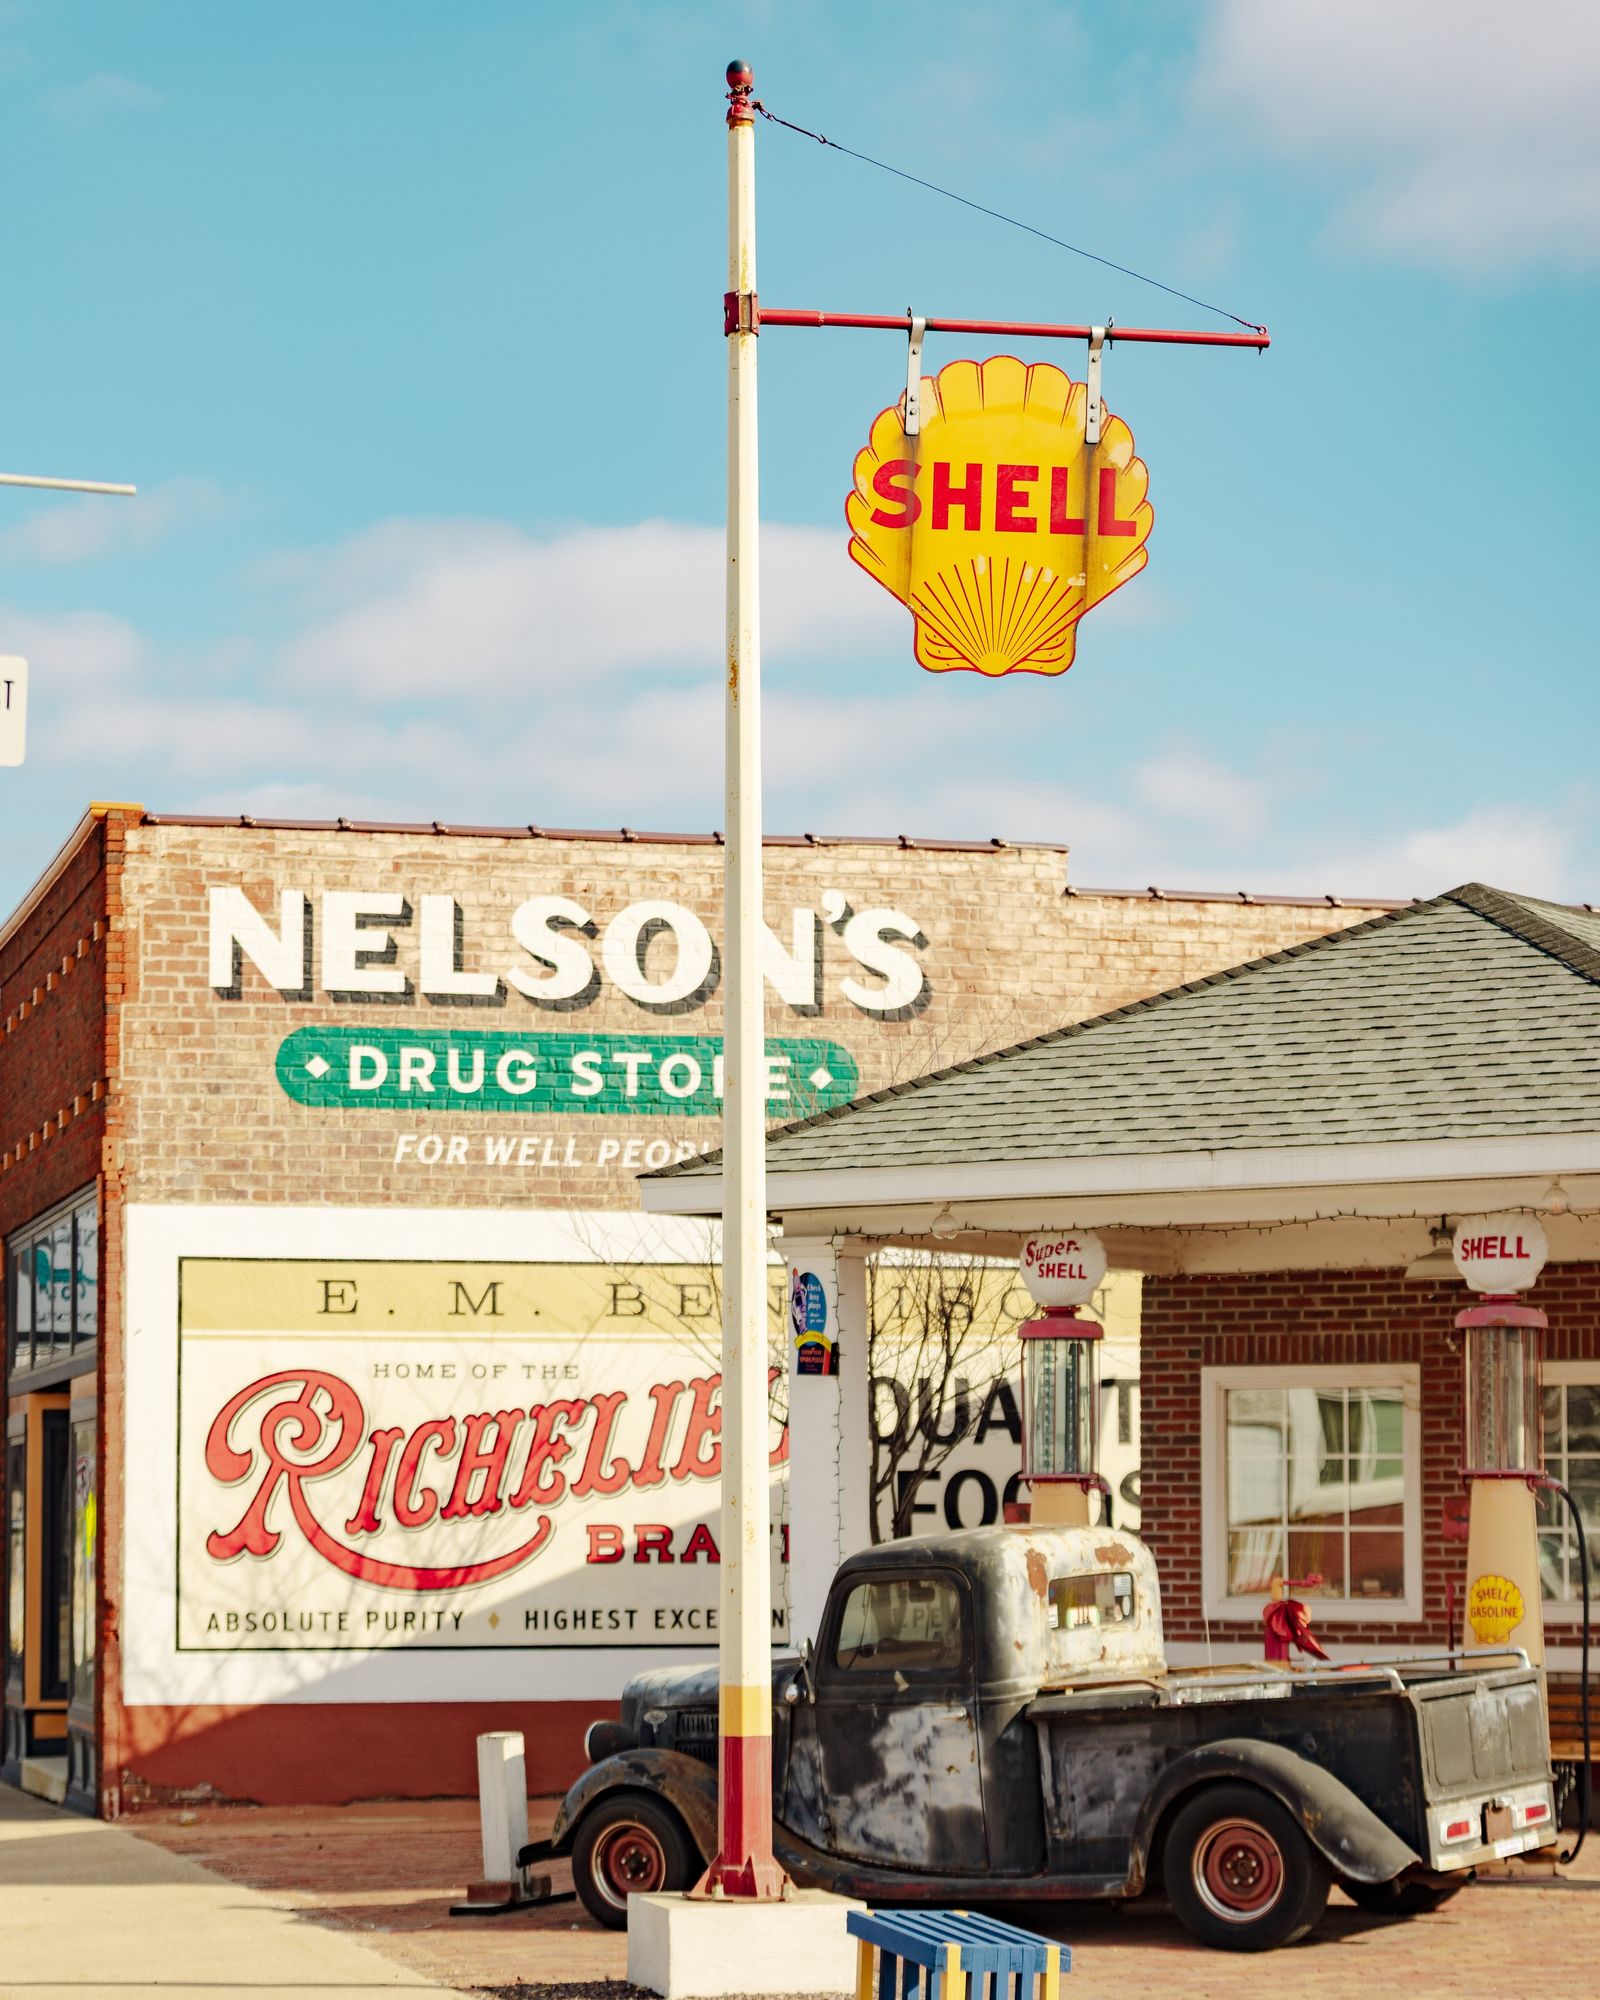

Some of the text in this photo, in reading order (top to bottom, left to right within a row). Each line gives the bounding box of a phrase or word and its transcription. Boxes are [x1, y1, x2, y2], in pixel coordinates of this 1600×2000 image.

[870, 459, 1137, 537] SHELL
[208, 886, 928, 1017] NELSON'S
[349, 1045, 539, 1095] DRUG
[394, 1135, 711, 1169] FOR WELL PEOP
[1461, 1235, 1530, 1261] SHELL
[1038, 1262, 1088, 1279] SHELL
[315, 1279, 397, 1316] E.
[447, 1281, 541, 1317] M.
[373, 1363, 580, 1381] HOME OF THE
[1476, 1588, 1510, 1603] SHELL
[206, 1610, 465, 1633] ABSOLUTE PURITY
[524, 1609, 638, 1632] HIGHEST
[1471, 1605, 1518, 1618] GASOLINE
